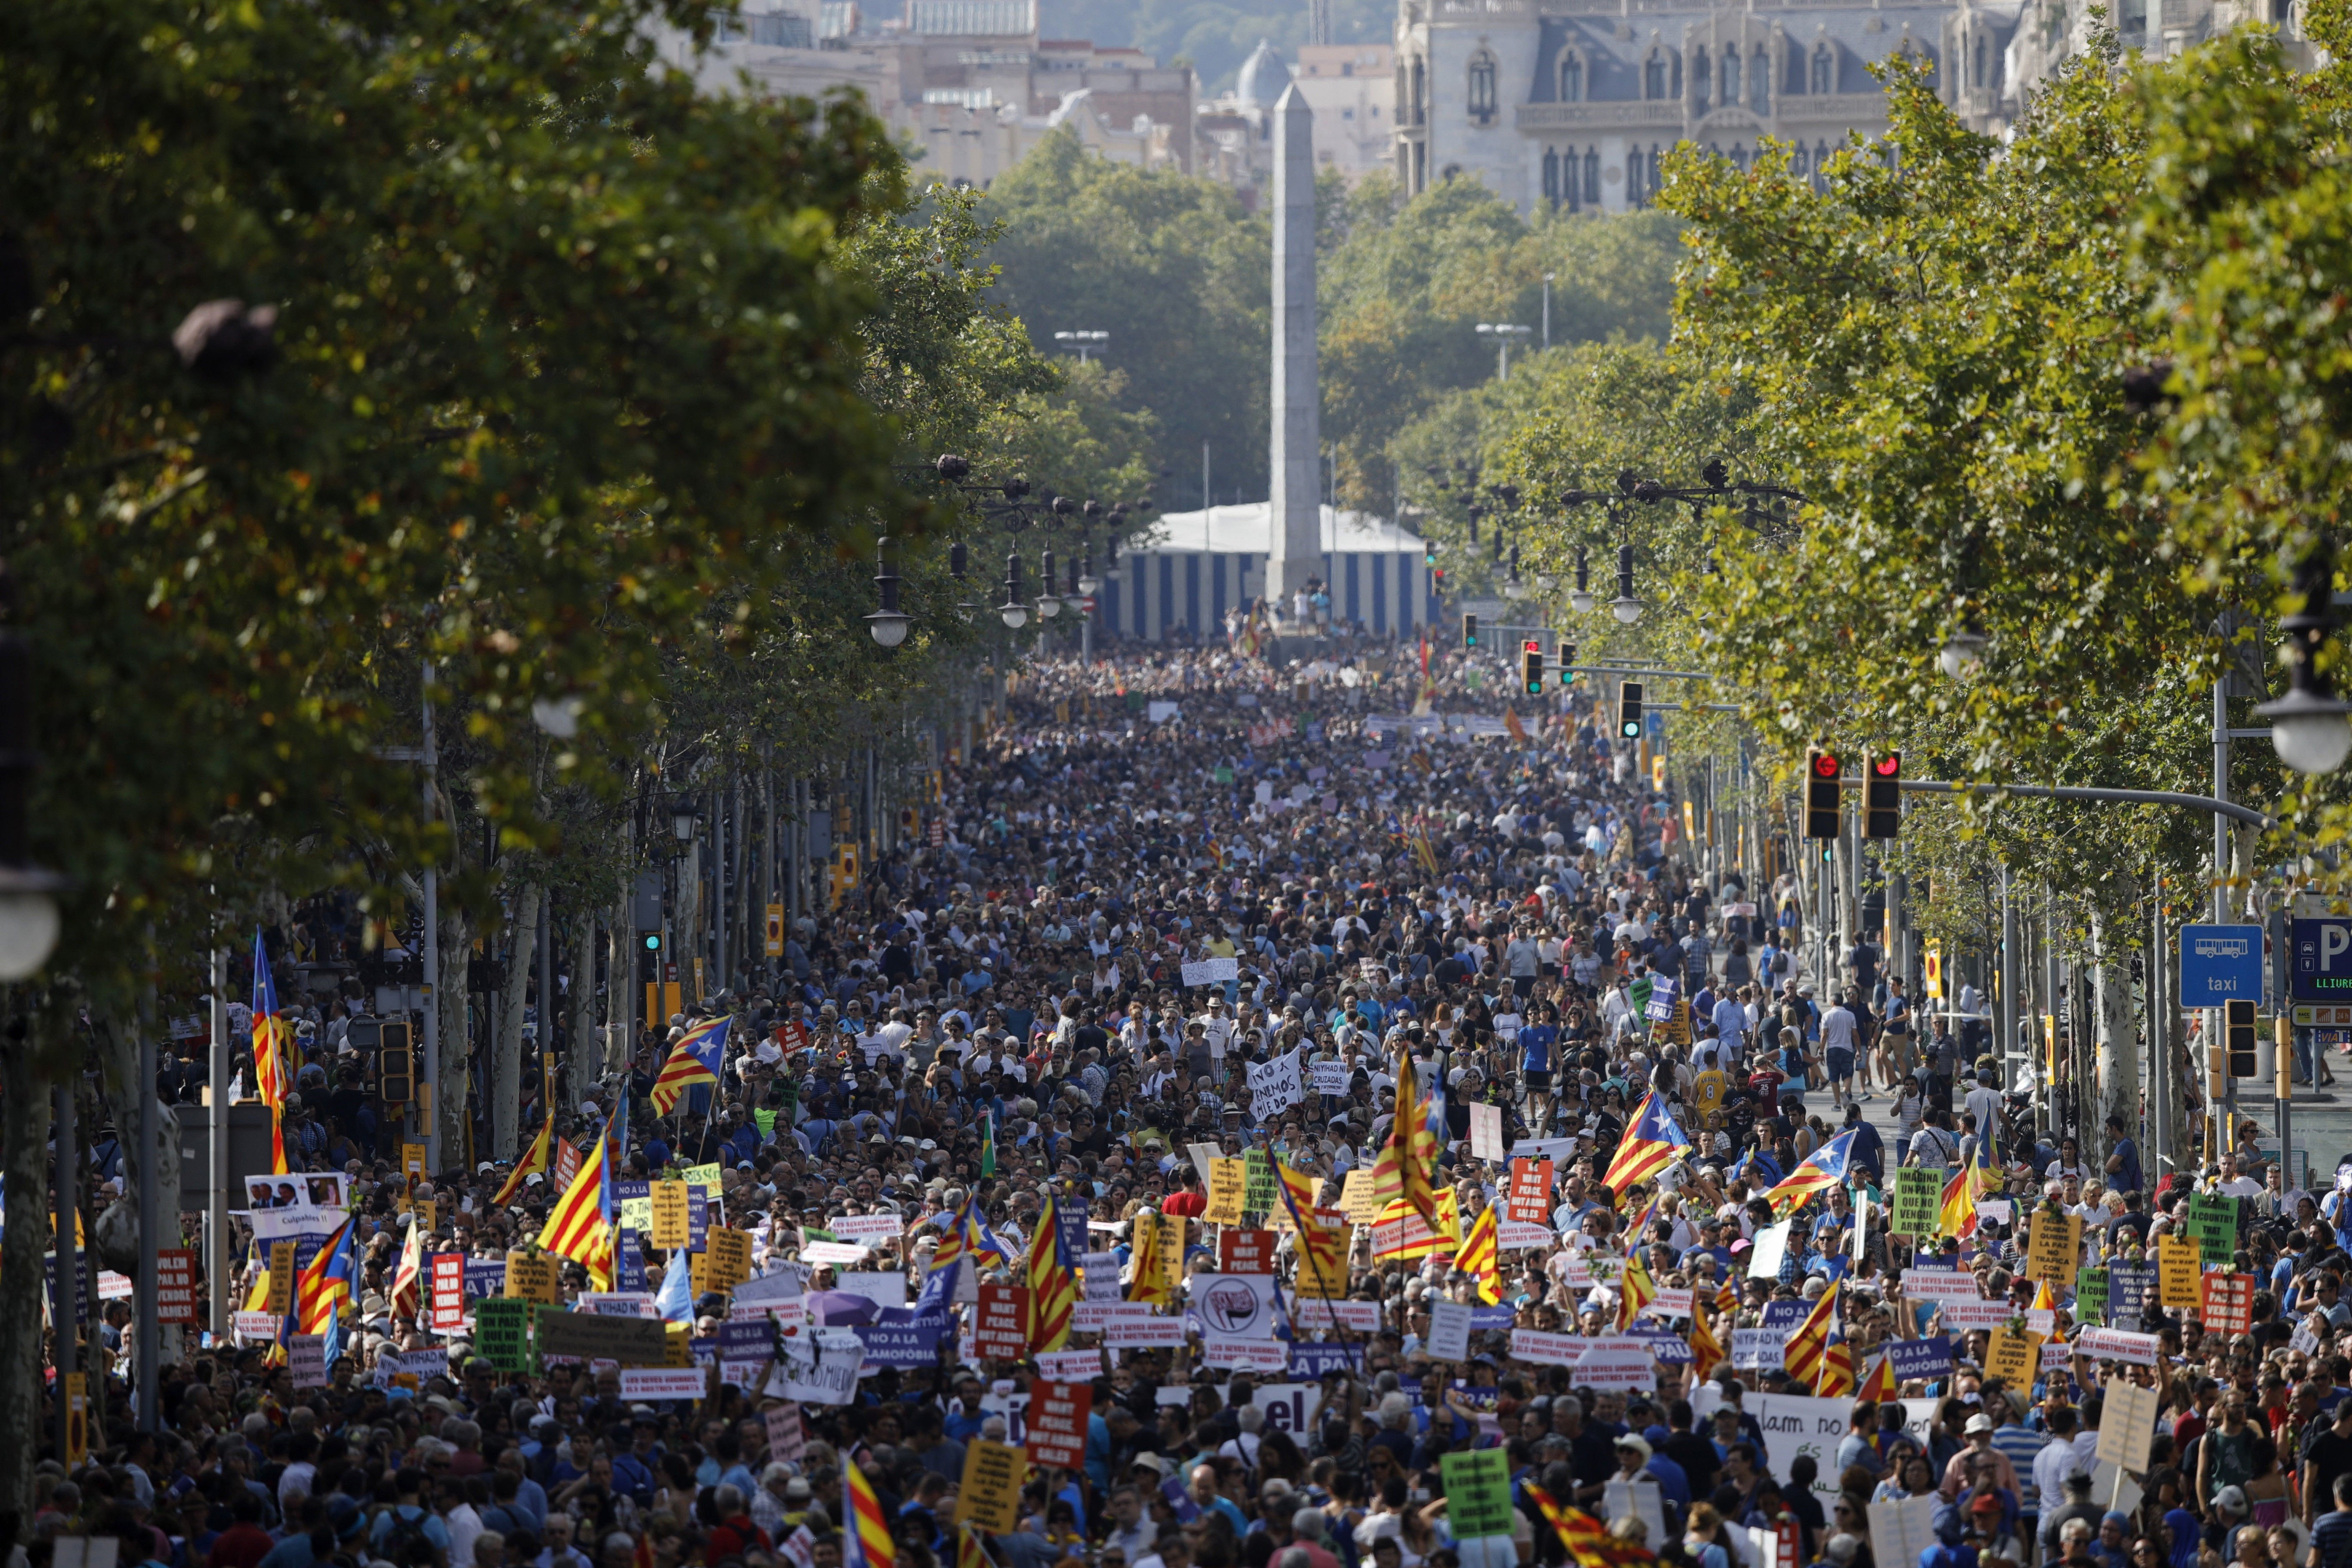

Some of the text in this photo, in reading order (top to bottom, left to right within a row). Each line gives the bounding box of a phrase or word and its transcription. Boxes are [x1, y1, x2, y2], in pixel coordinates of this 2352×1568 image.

[2321, 925, 2350, 971] P
[2208, 976, 2236, 991] taxi
[1653, 1006, 1672, 1019] PAU
[786, 1025, 794, 1034] WE
[784, 1032, 799, 1042] WANT
[567, 1145, 574, 1157] WE
[563, 1154, 575, 1169] WANT
[1250, 1165, 1261, 1175] UN
[557, 1170, 565, 1183] NOT
[1522, 1174, 1542, 1183] WANT
[1900, 1172, 1939, 1183] IMAGINA
[639, 1185, 647, 1193] LA
[1248, 1189, 1277, 1198] VENGUI
[1902, 1183, 1936, 1195] UN PAÍS
[1248, 1200, 1275, 1209] ARMES
[1511, 1197, 1546, 1207] NOT ARMS
[1902, 1198, 1933, 1208] QUE NO
[623, 1205, 634, 1216] NO
[1516, 1209, 1539, 1218] SALES
[1900, 1209, 1932, 1219] VENGUI
[282, 1214, 319, 1224] Culpables
[2198, 1213, 2234, 1224] COUNTRY
[1900, 1222, 1932, 1232] ARMES
[2203, 1225, 2221, 1235] THAT
[1240, 1233, 1253, 1243] WE
[2040, 1233, 2070, 1241] QUIERE
[719, 1241, 742, 1249] QUIEN
[1233, 1246, 1259, 1257] WANT
[157, 1257, 187, 1270] VOLEM
[2035, 1256, 2070, 1265] TRAFICA
[436, 1262, 459, 1276] VOLEM
[532, 1269, 550, 1277] VOL
[2113, 1268, 2155, 1276] MARIANO
[157, 1273, 189, 1286] PAU, NO
[528, 1278, 548, 1286] PAU
[2211, 1278, 2246, 1291] VOLEM
[997, 1288, 1011, 1300] WE
[1920, 1285, 1951, 1293] NOSTRES
[2080, 1286, 2086, 1294] A
[435, 1293, 460, 1308] VENDRE
[2231, 1293, 2245, 1304] NO
[157, 1305, 192, 1318] ARMES!
[480, 1303, 523, 1313] IMAGINA
[990, 1302, 1017, 1315] WANT
[1775, 1307, 1793, 1317] NO
[2206, 1305, 2246, 1318] VENDRE
[482, 1316, 520, 1328] UN PAÍS
[2205, 1318, 2245, 1330] ARMES!
[483, 1331, 518, 1341] QUE NO
[869, 1333, 919, 1344] NO A LA
[978, 1329, 1025, 1343] NOT ARMS
[482, 1344, 517, 1355] VENGUI
[985, 1344, 1014, 1357] SALES
[2002, 1341, 2026, 1350] QUIEN
[1653, 1343, 1692, 1360] PAU
[1905, 1345, 1931, 1358] A LA
[1997, 1350, 2027, 1359] QUIERE
[1053, 1385, 1070, 1399] WE
[1044, 1399, 1075, 1415] WANT
[1818, 1419, 1842, 1435] no
[1028, 1429, 1083, 1450] NOT ARMS
[1037, 1446, 1071, 1464] SALES
